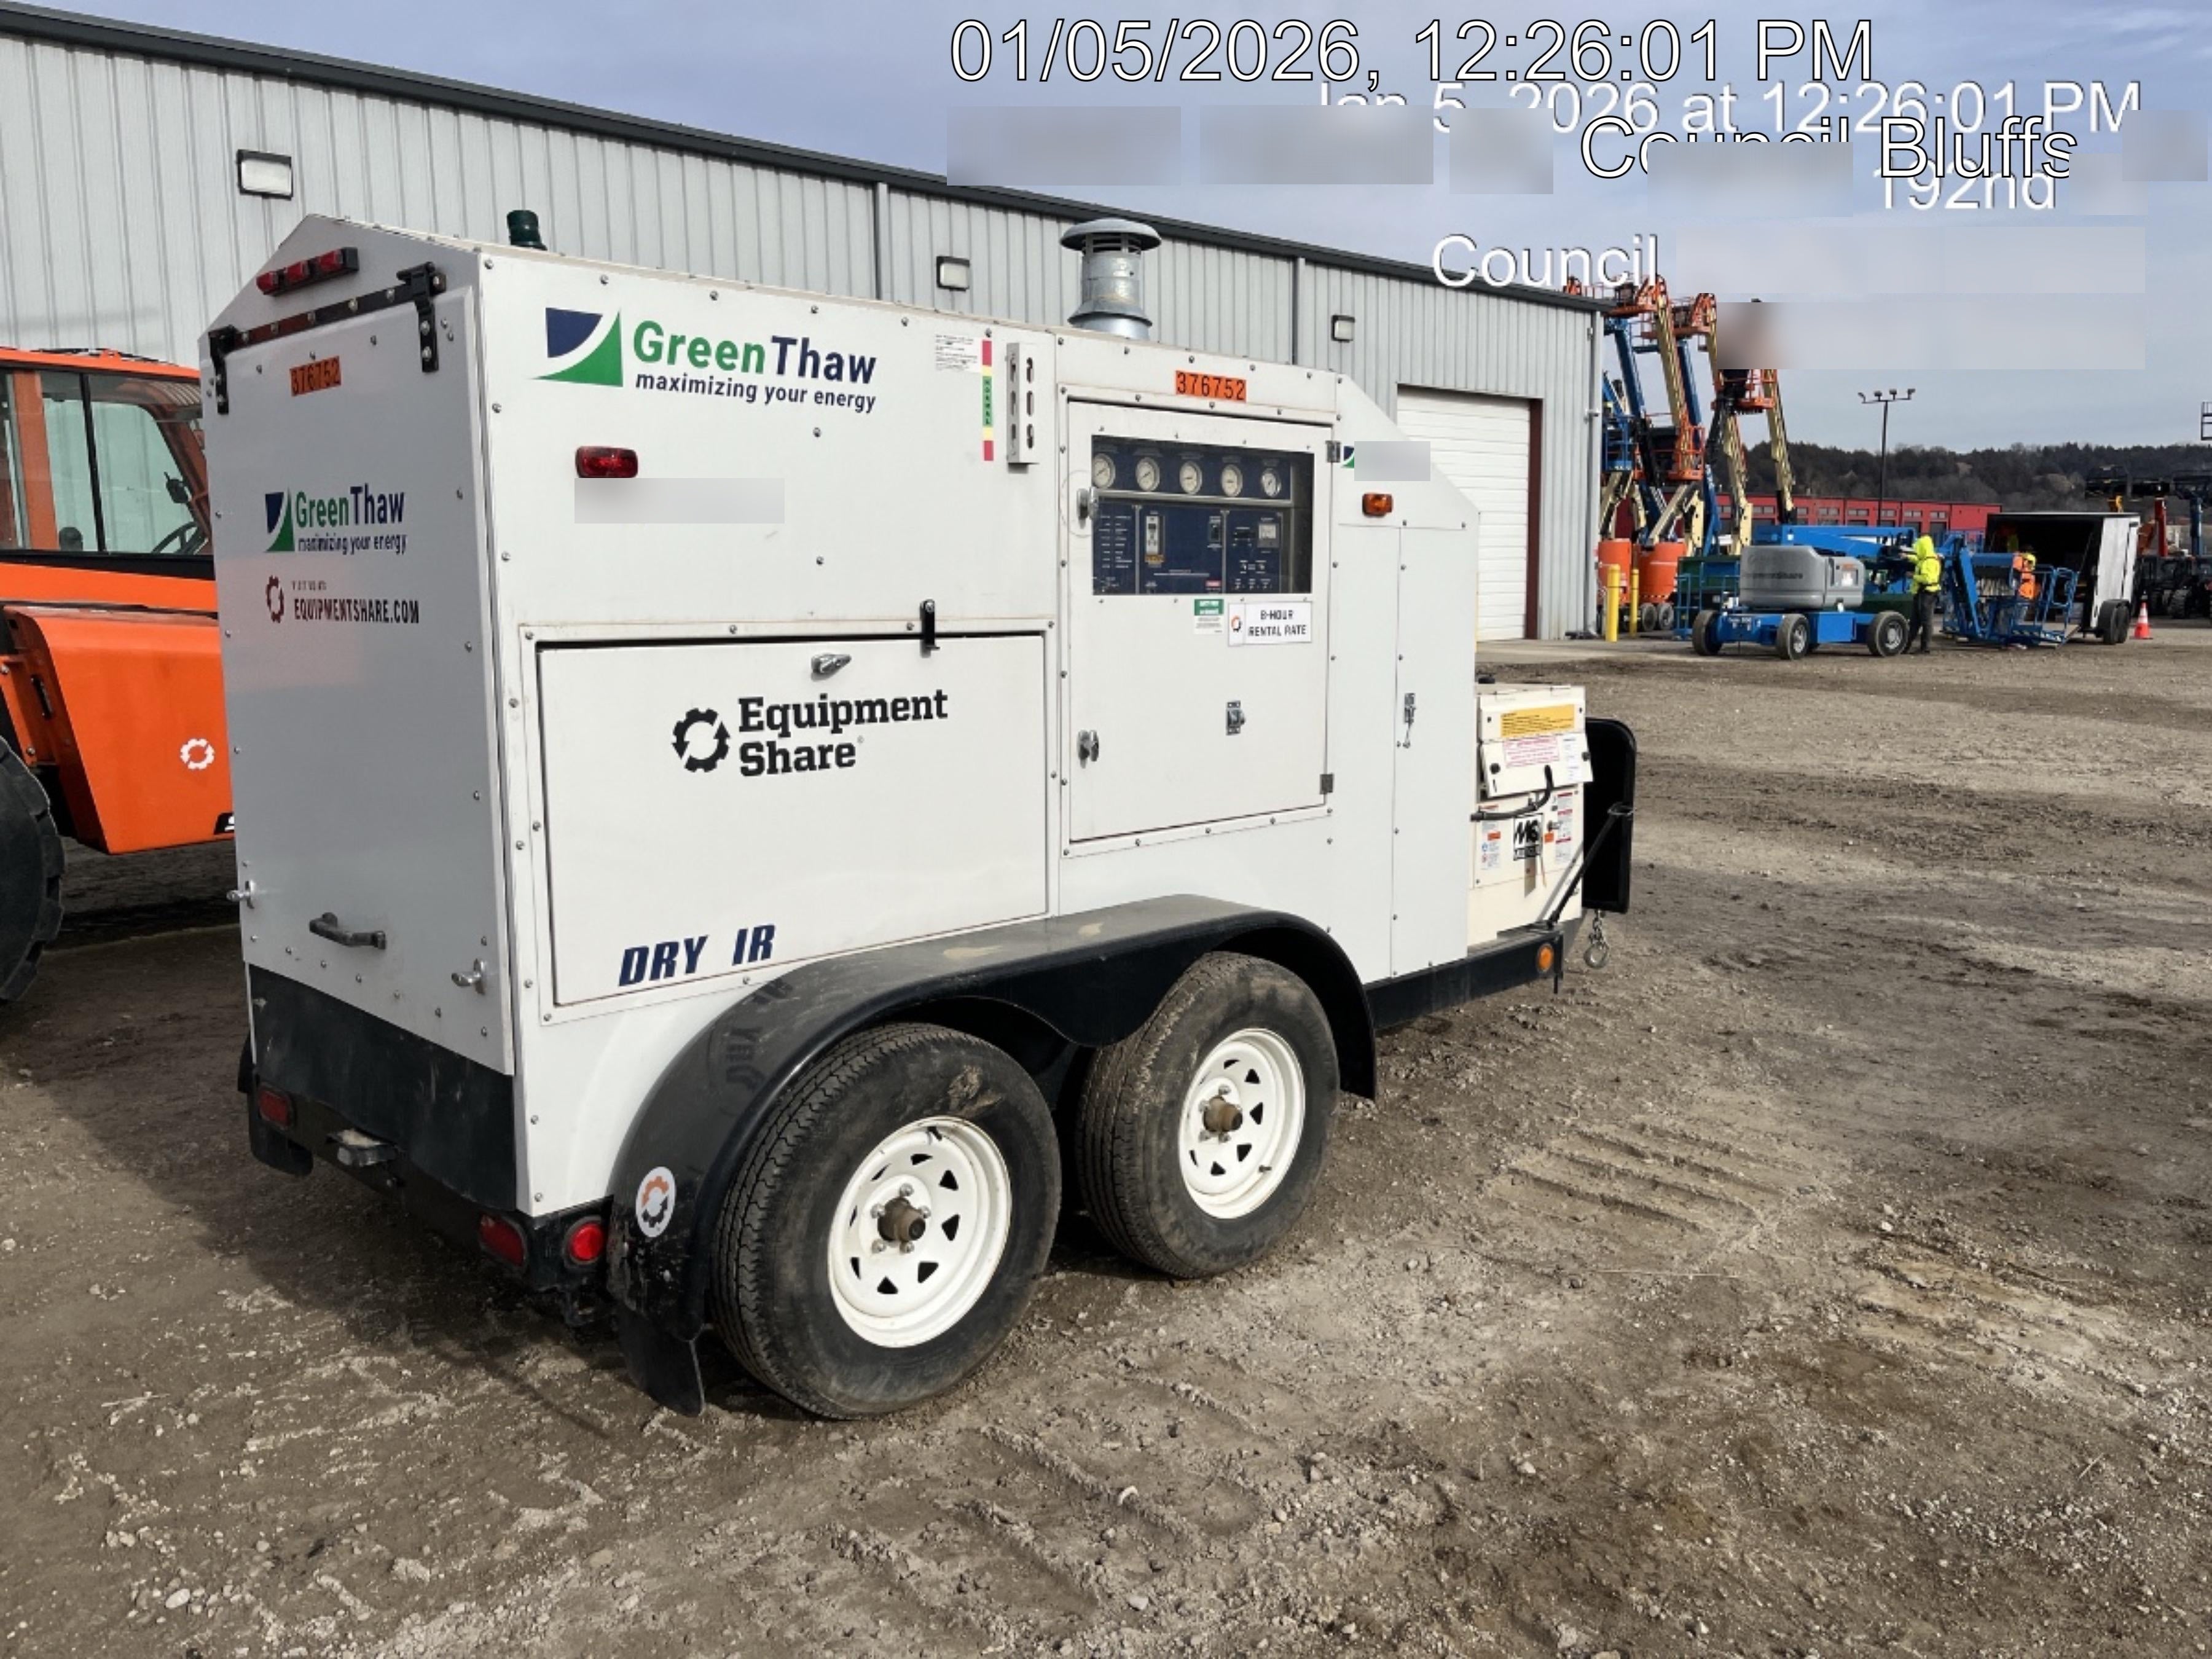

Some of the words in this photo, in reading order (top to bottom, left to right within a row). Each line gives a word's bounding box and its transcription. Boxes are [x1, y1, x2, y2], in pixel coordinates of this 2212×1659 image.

[633, 320, 877, 385] GreenThaw
[635, 372, 758, 404] maximizing
[764, 385, 808, 405] your
[814, 390, 876, 414] energy
[1177, 371, 1245, 401] 376752
[296, 483, 405, 528] GreenThaw
[298, 533, 348, 555] maximizing
[351, 536, 371, 555] your
[374, 535, 408, 555] energy
[294, 598, 420, 624] EQUIPMENTSHARE.COM
[1248, 626, 1282, 637] RENTAL
[1284, 624, 1307, 635] RATE
[738, 689, 948, 738] Equipment
[739, 739, 857, 777] Share
[618, 934, 709, 987] DRY
[732, 923, 776, 967] IR
